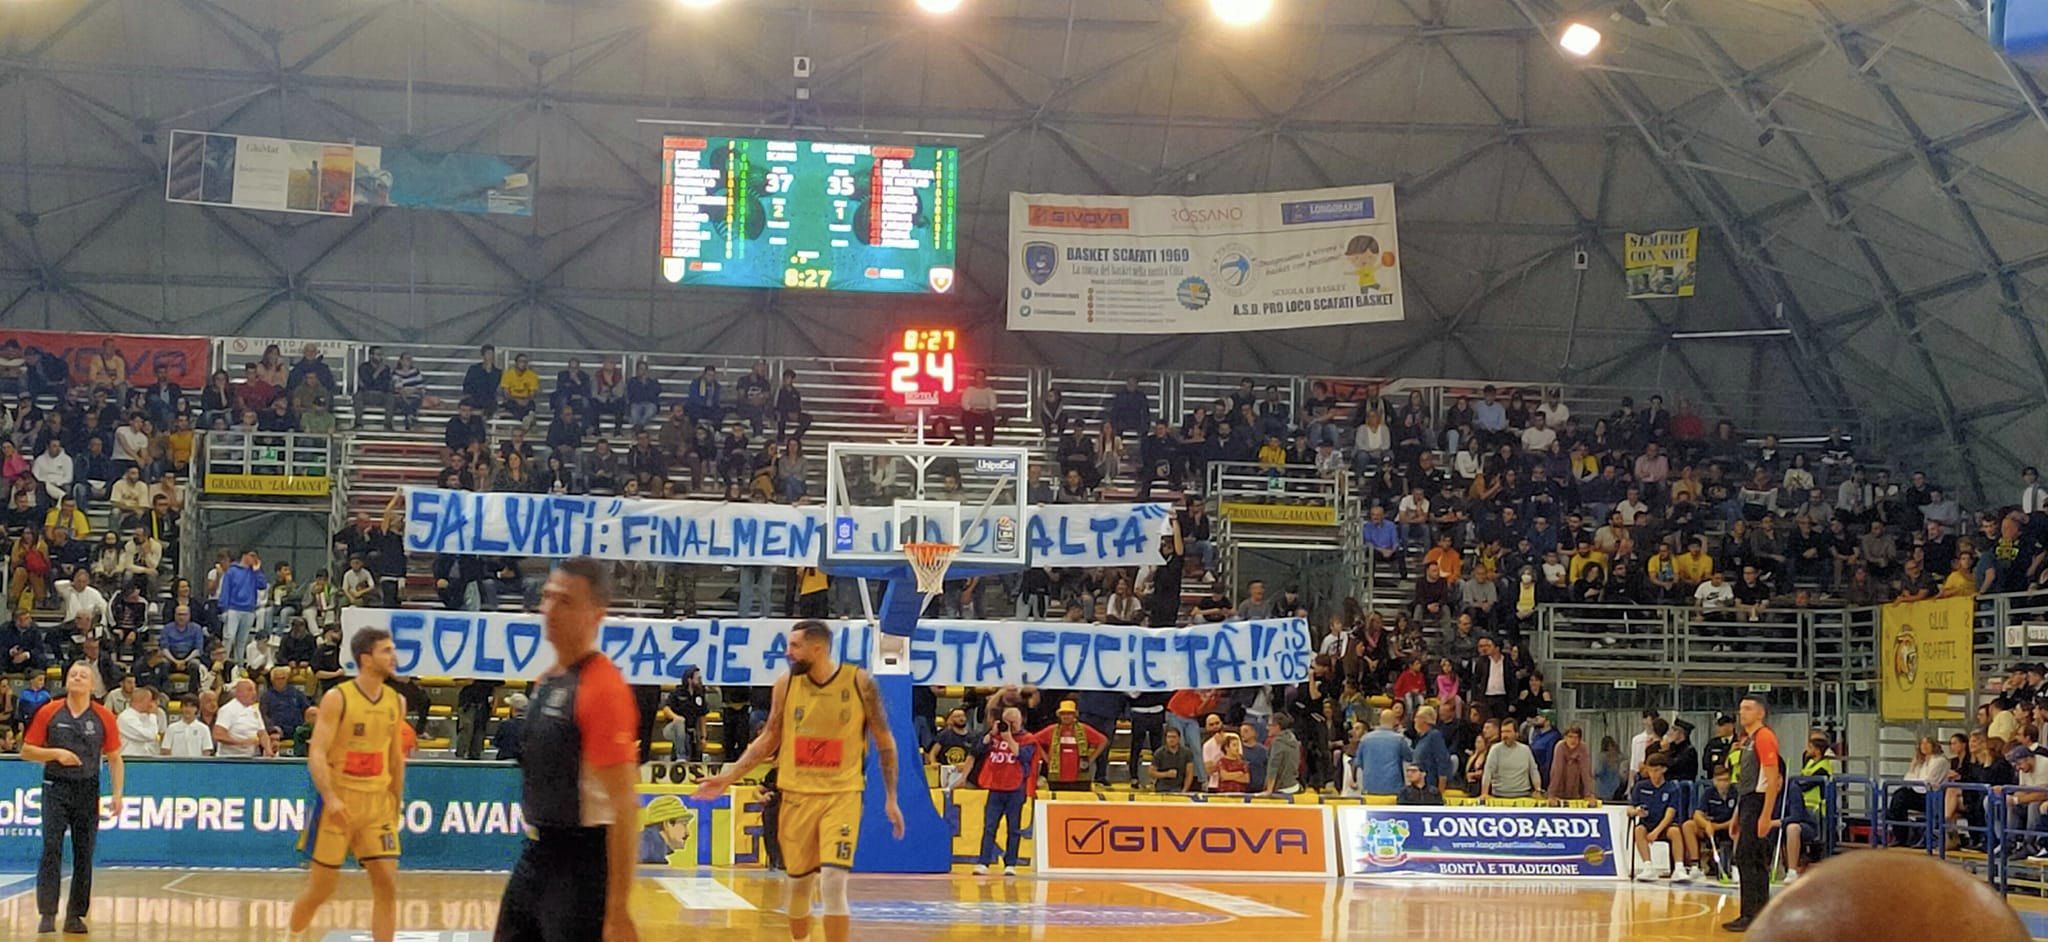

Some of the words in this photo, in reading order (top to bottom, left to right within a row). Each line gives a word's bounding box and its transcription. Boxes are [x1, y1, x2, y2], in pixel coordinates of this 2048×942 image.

[765, 173, 794, 193] 37
[826, 176, 855, 196] 35
[773, 205, 784, 218] 2
[835, 207, 844, 220] 1
[1052, 210, 1122, 224] GIVOVA
[1171, 207, 1243, 224] ROSSANO
[1066, 247, 1110, 262] BASKET
[1113, 248, 1157, 263] SCAFATI
[1160, 248, 1190, 263] 1969
[1630, 250, 1656, 262] CON
[785, 268, 832, 288] 8:27
[1263, 302, 1284, 315] PRO
[1286, 300, 1311, 313] LOCO
[1314, 297, 1354, 311] SCAFATI
[1356, 293, 1394, 308] BASKET
[904, 330, 955, 351] 8:27
[891, 352, 954, 393] 24
[600, 619, 752, 683] RAZiE
[98, 795, 245, 831] SEMPRE
[253, 798, 305, 832] UN
[441, 801, 525, 834] AVAN
[1421, 817, 1601, 838] LONGOBARDI
[1109, 826, 1309, 855] GIVOVA
[836, 841, 852, 861] 15
[1439, 861, 1486, 875] BONTÀ
[1488, 863, 1498, 875] E
[1498, 863, 1580, 875] TRADIZIONE
